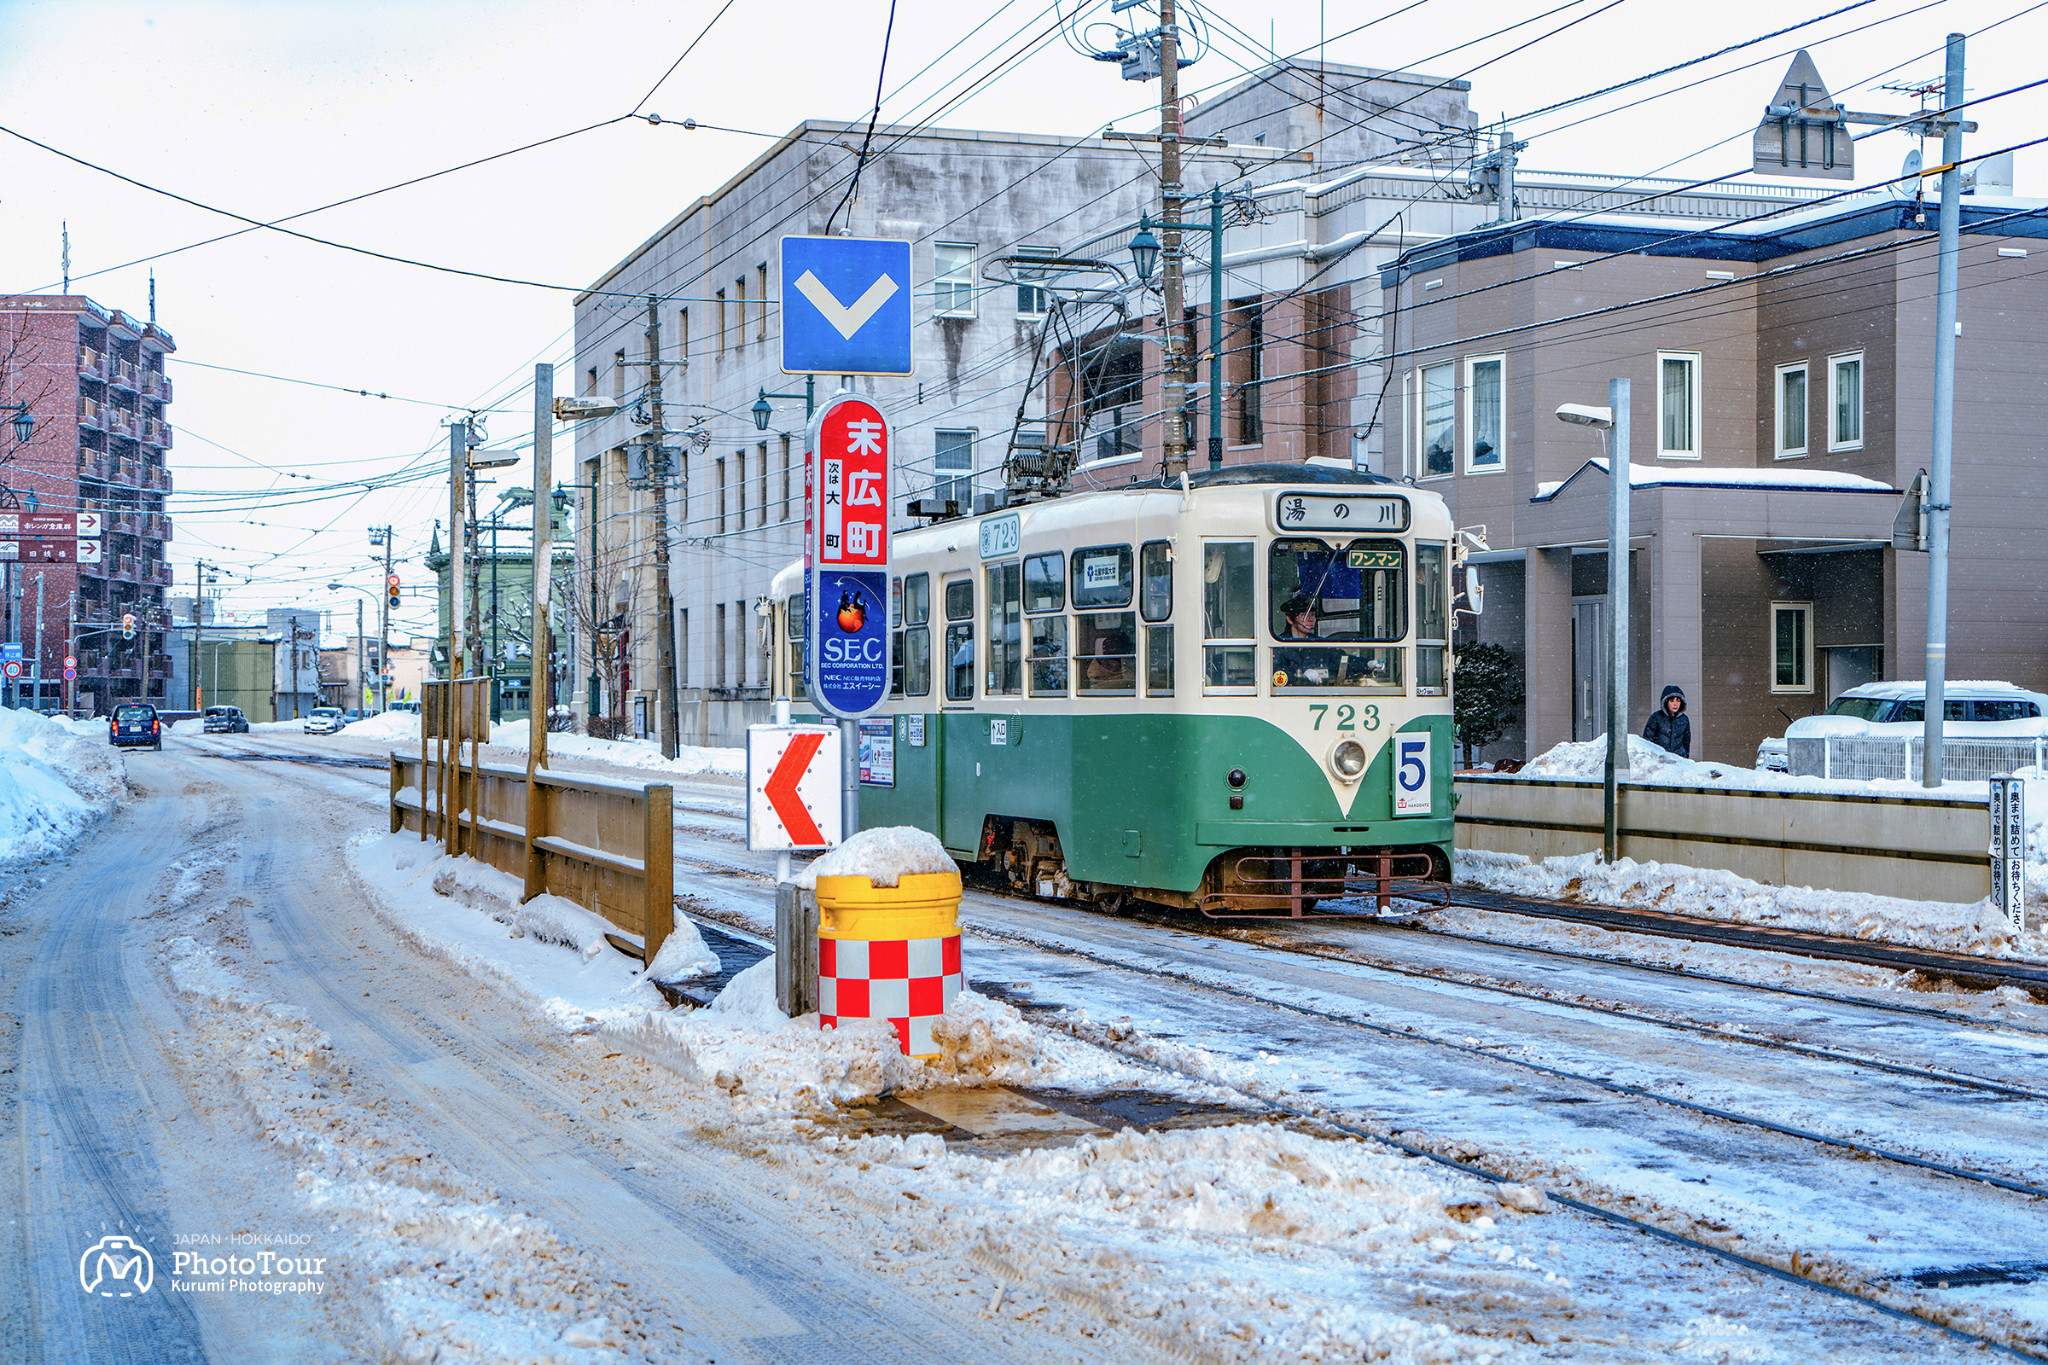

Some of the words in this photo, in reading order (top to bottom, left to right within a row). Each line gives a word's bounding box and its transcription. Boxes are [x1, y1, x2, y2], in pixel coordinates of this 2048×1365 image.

[846, 418, 882, 557] 末広町
[994, 520, 1017, 550] 723
[1352, 552, 1400, 566] ワンマン
[824, 637, 881, 661] SEC
[8, 665, 18, 674] 40
[996, 722, 1006, 737] 入口
[1309, 704, 1380, 731] 723
[1399, 742, 1426, 792] 5
